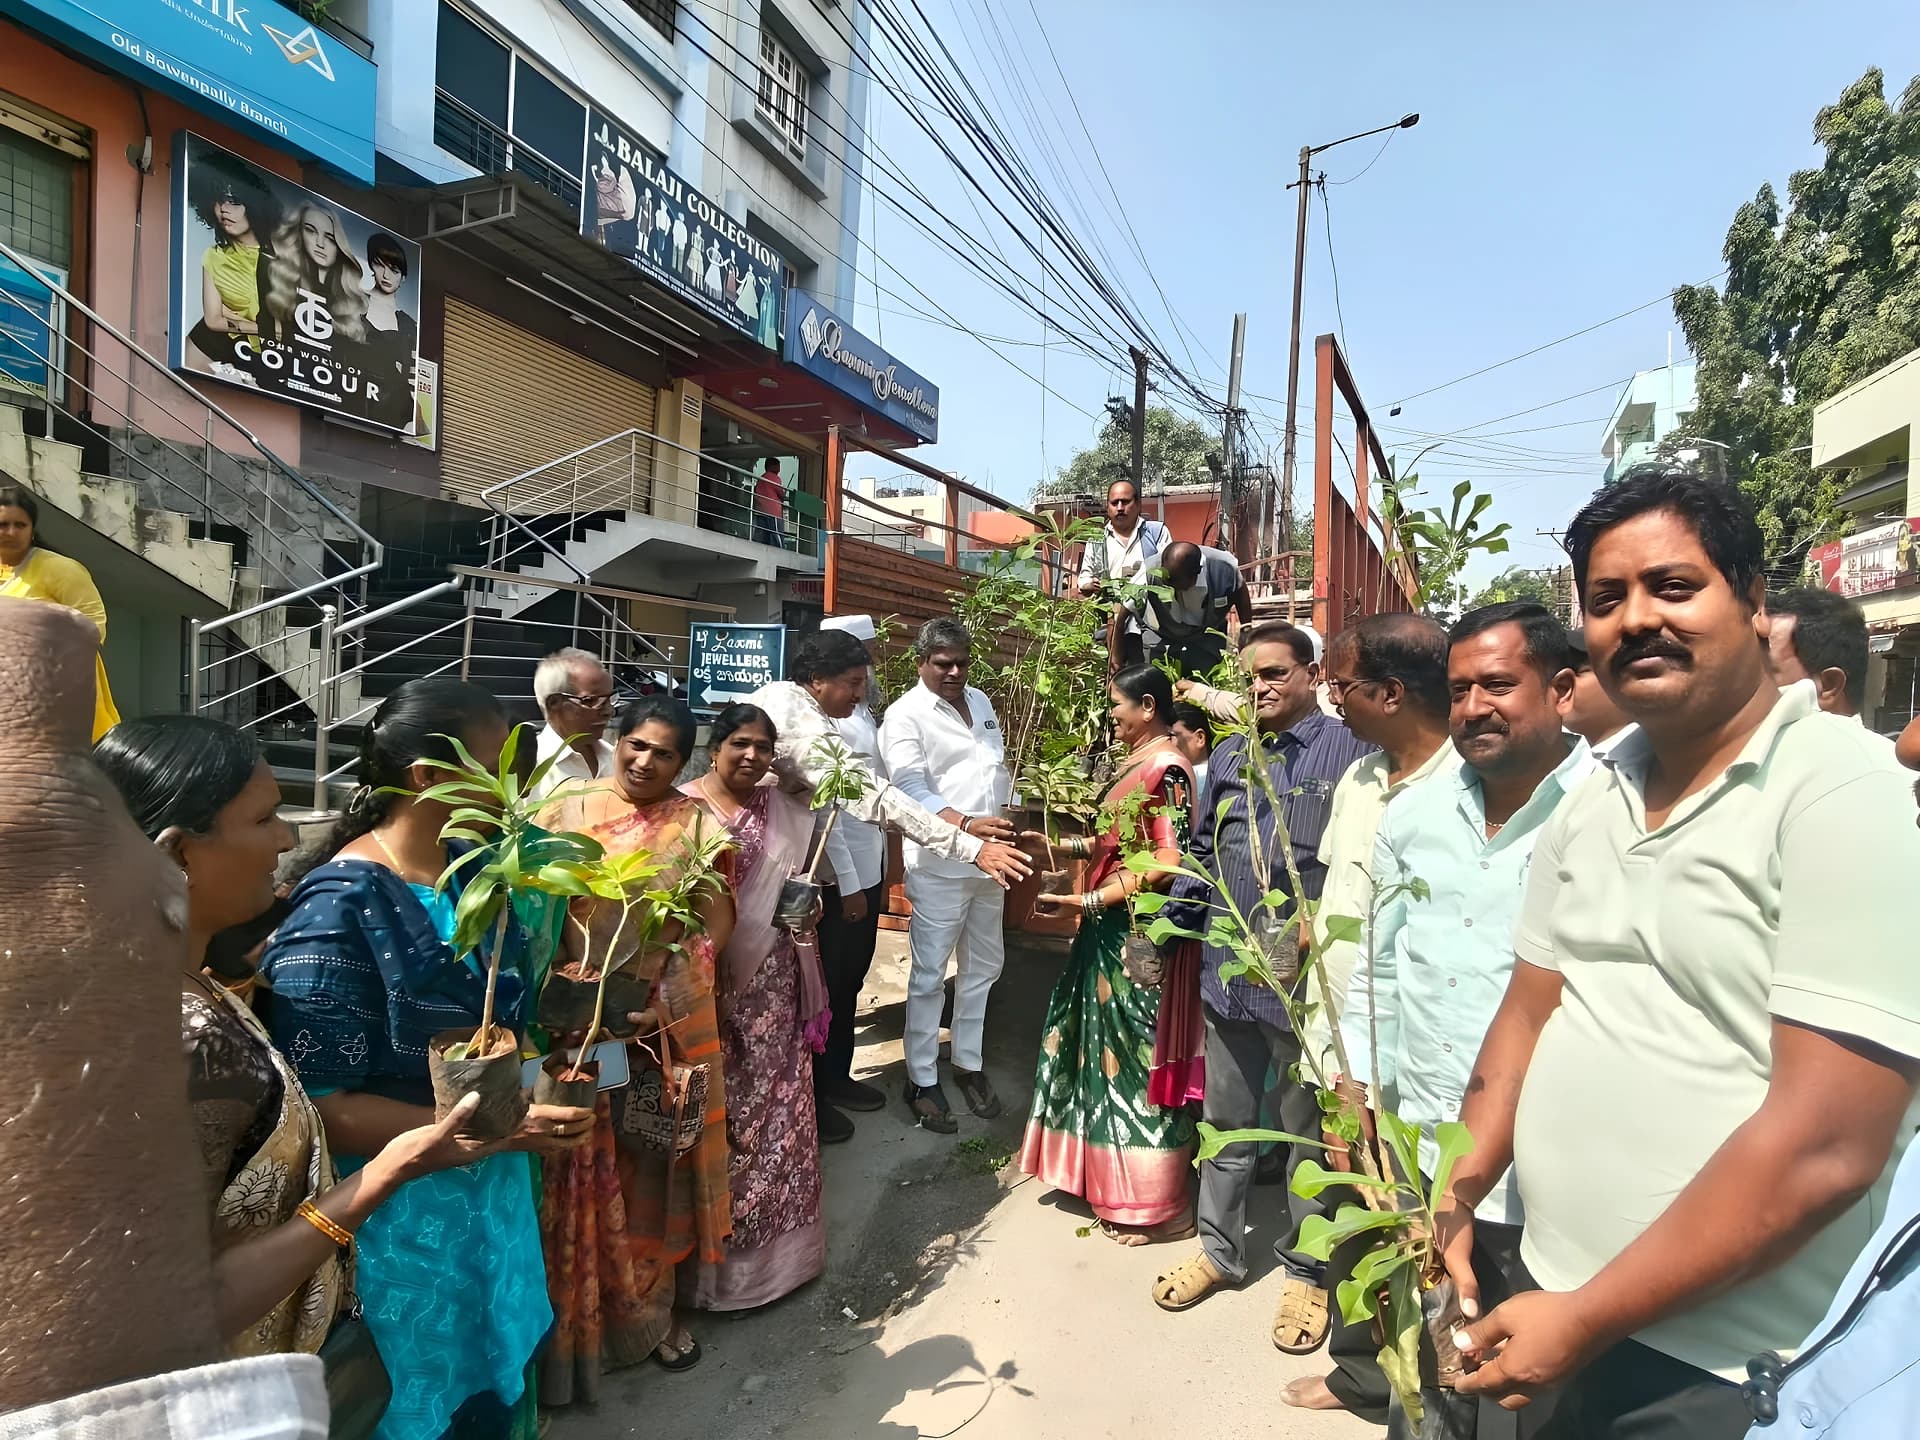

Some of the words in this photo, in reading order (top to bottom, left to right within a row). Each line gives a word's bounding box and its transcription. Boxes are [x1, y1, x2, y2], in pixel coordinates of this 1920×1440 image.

[111, 32, 140, 57] Old
[240, 101, 288, 136] Branch
[617, 134, 683, 204] BALAJI
[687, 192, 780, 274] COLLECTION
[234, 340, 380, 402] COLOUR
[701, 652, 769, 668] JEWELLERS
[711, 631, 764, 652] Laxmi
